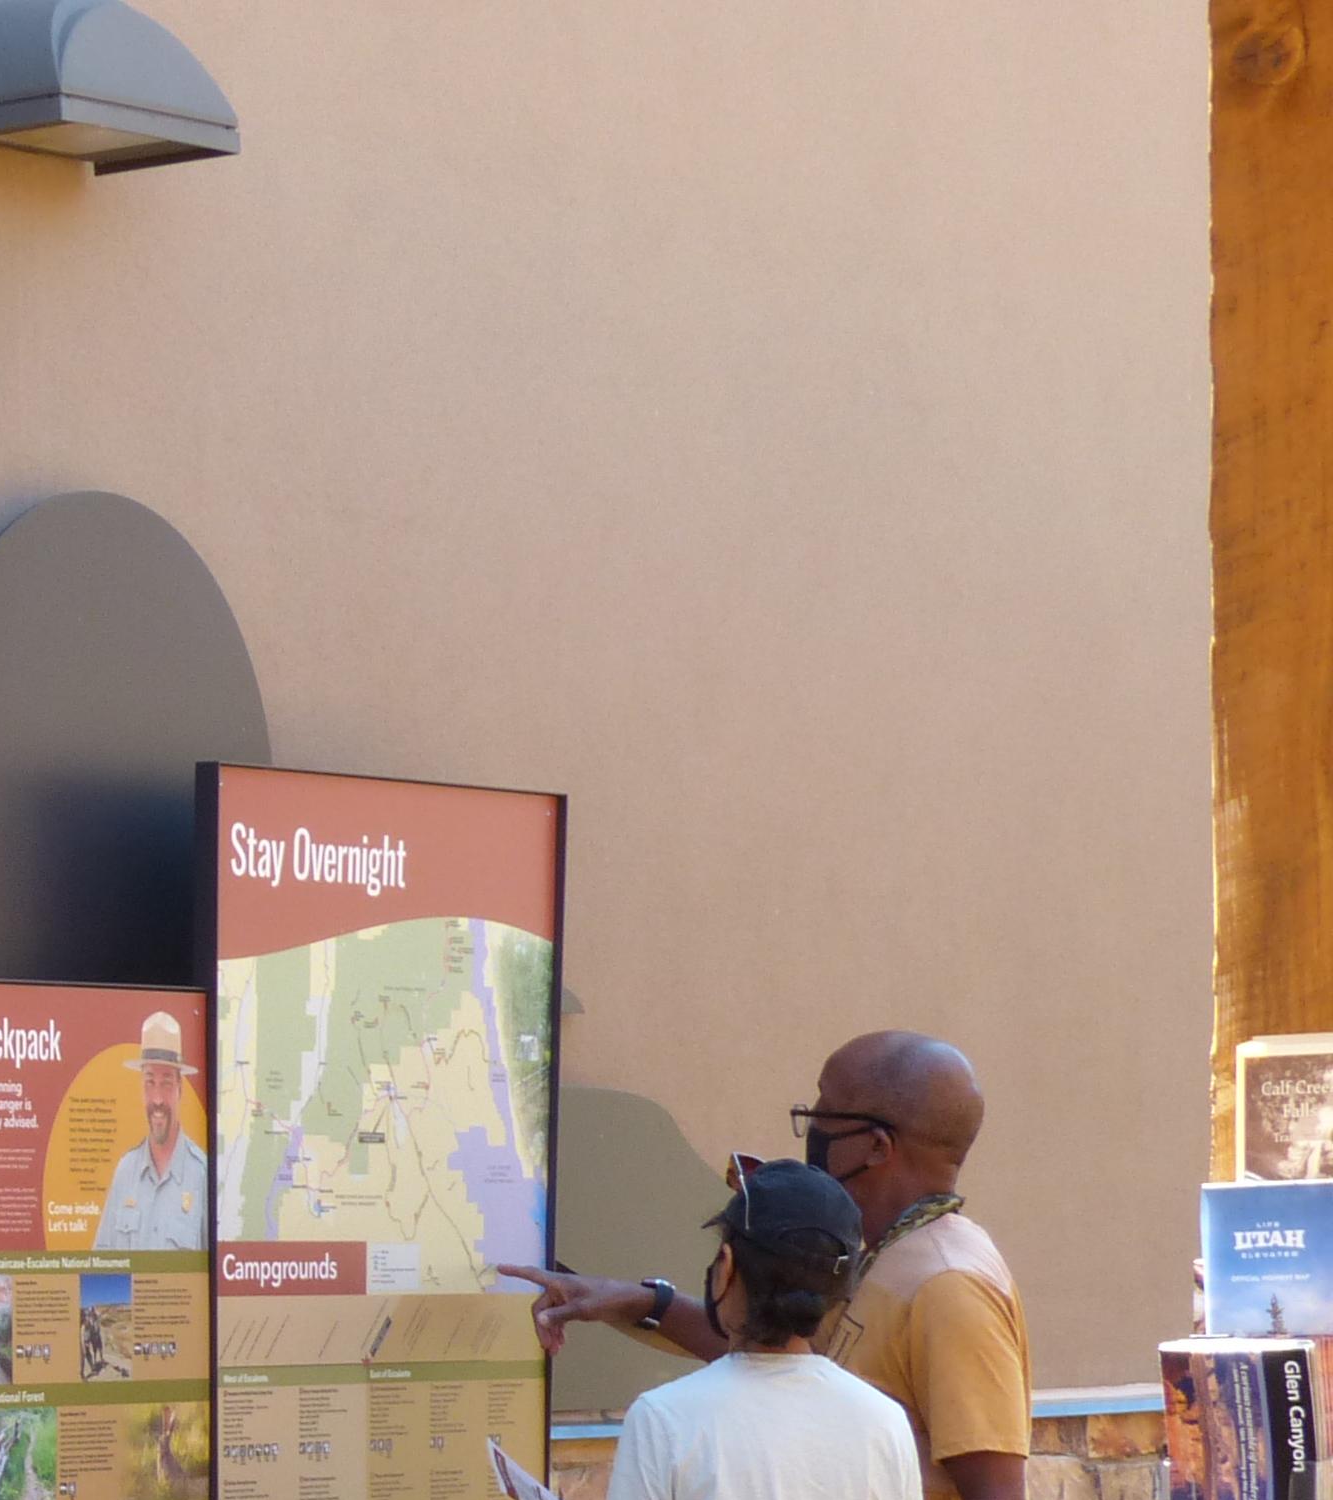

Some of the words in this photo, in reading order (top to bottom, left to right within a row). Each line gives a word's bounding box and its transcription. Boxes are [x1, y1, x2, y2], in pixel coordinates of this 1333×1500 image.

[231, 822, 285, 888] Stay
[293, 826, 406, 896] Overnight
[1261, 1079, 1292, 1096] Calf
[24, 1098, 32, 1110] is
[4, 1115, 39, 1129] advised.
[48, 1201, 73, 1215] Come
[74, 1201, 101, 1215] inside.
[48, 1220, 67, 1232] Let's
[69, 1220, 87, 1232] talk!
[1233, 1229, 1306, 1250] UTAH
[1241, 1251, 1299, 1259] ELEVATED
[61, 1256, 92, 1269] National
[92, 1256, 131, 1269] Monument
[223, 1253, 337, 1293] Campgrounds
[1284, 1360, 1301, 1401] Glen
[23, 1390, 45, 1403] Forest
[1288, 1405, 1307, 1473] Canyon
